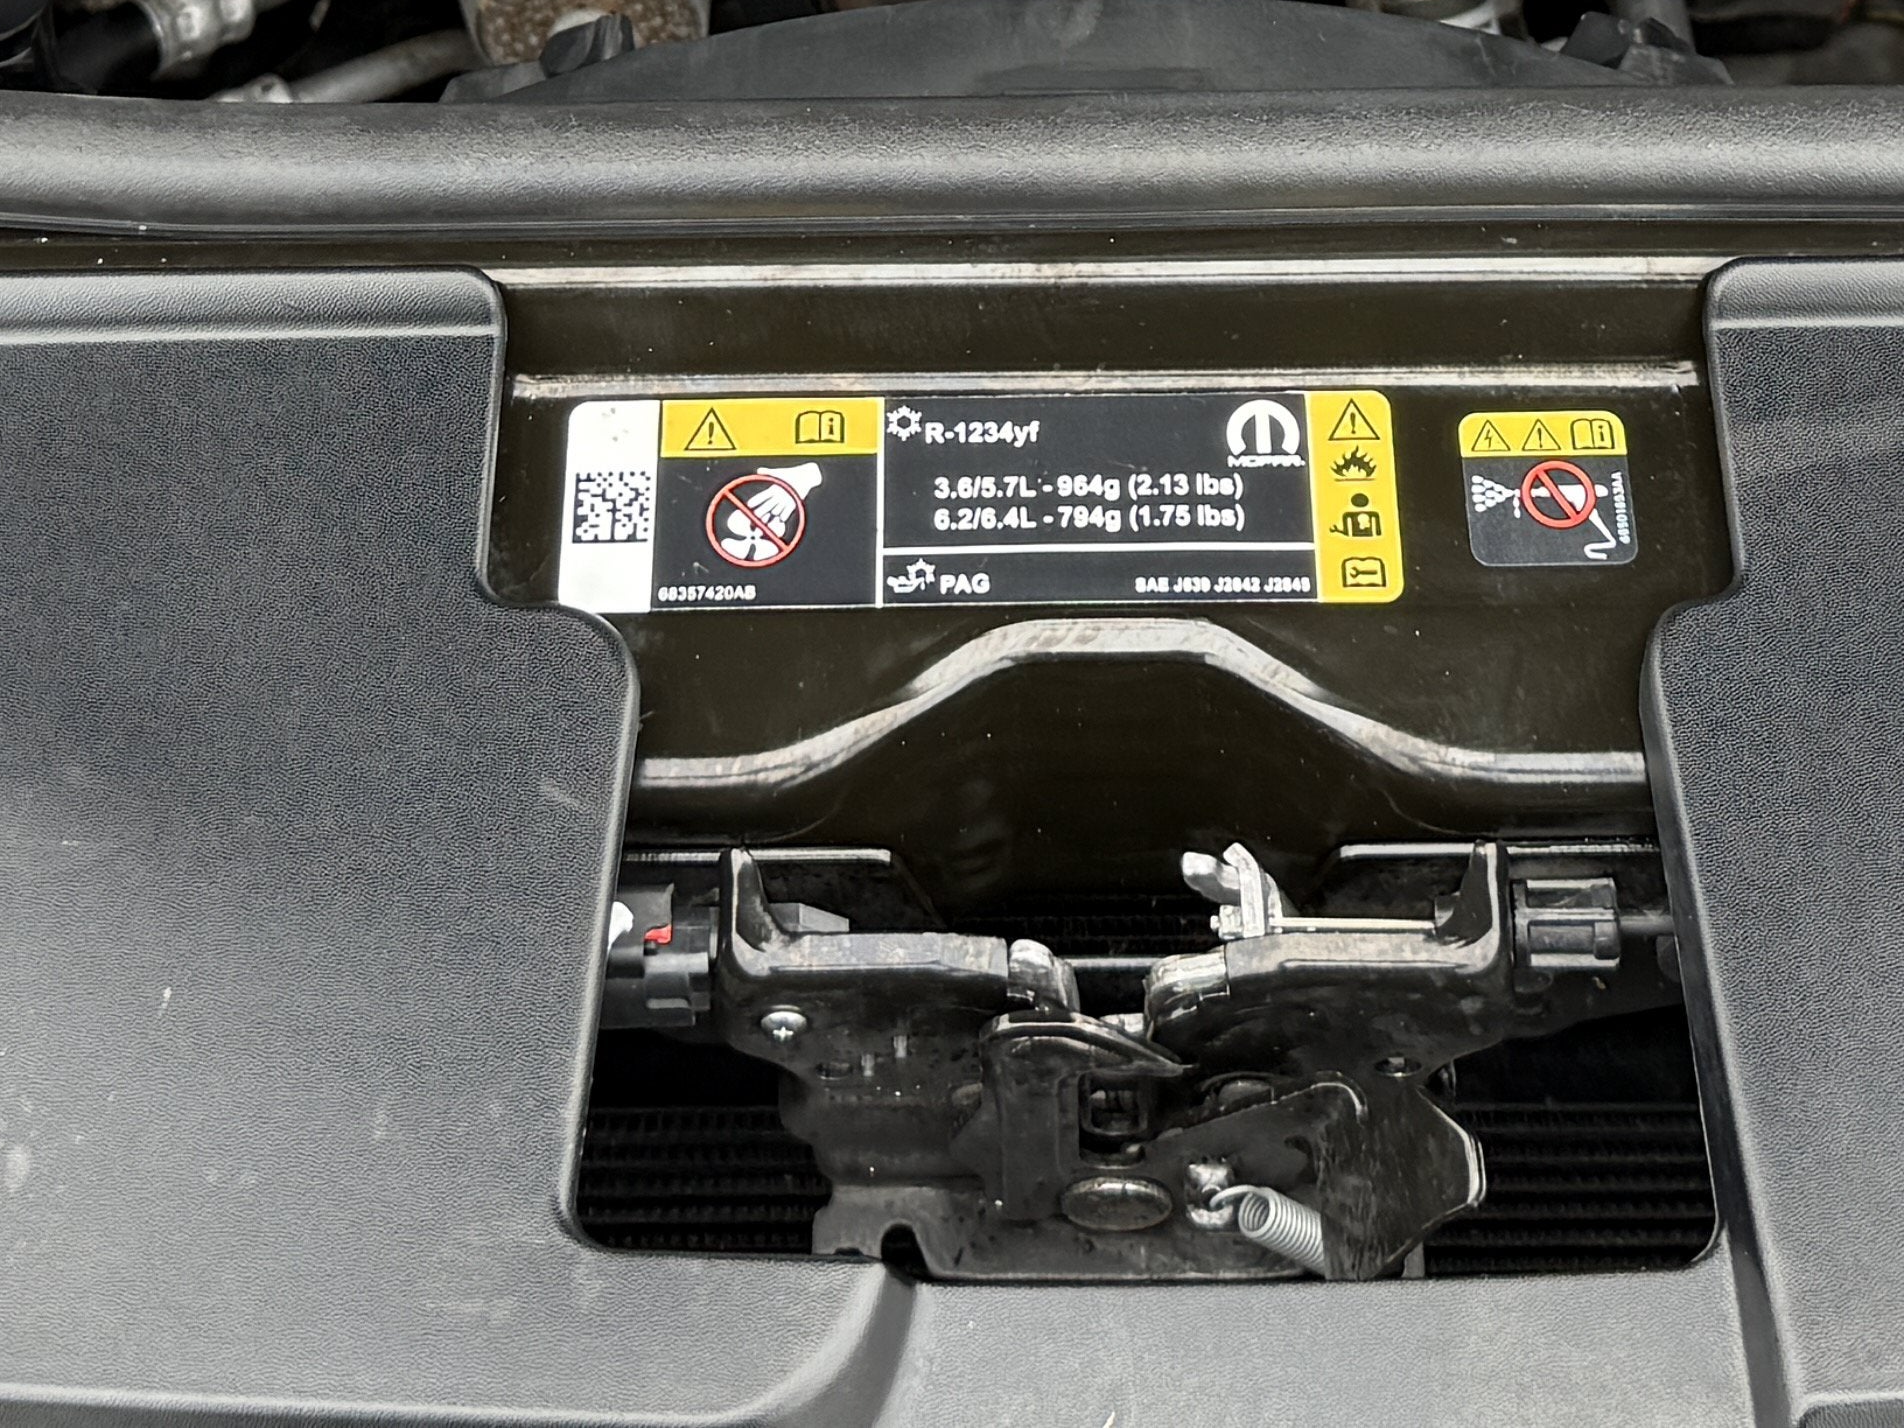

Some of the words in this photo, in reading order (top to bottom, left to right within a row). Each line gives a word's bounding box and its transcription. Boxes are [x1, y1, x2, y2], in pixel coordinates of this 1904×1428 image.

[924, 420, 1040, 447] R-1234yf
[933, 475, 1037, 500] 3.6/5.7L
[1056, 474, 1120, 500] 964g
[1128, 472, 1190, 499] (2.13
[1195, 472, 1244, 498] lbs)
[933, 505, 1037, 531] 6.2/6.4L
[1058, 505, 1122, 532] 794g
[1129, 504, 1191, 532] (1.75
[1196, 504, 1246, 531] lbs)
[939, 573, 991, 594] PAG
